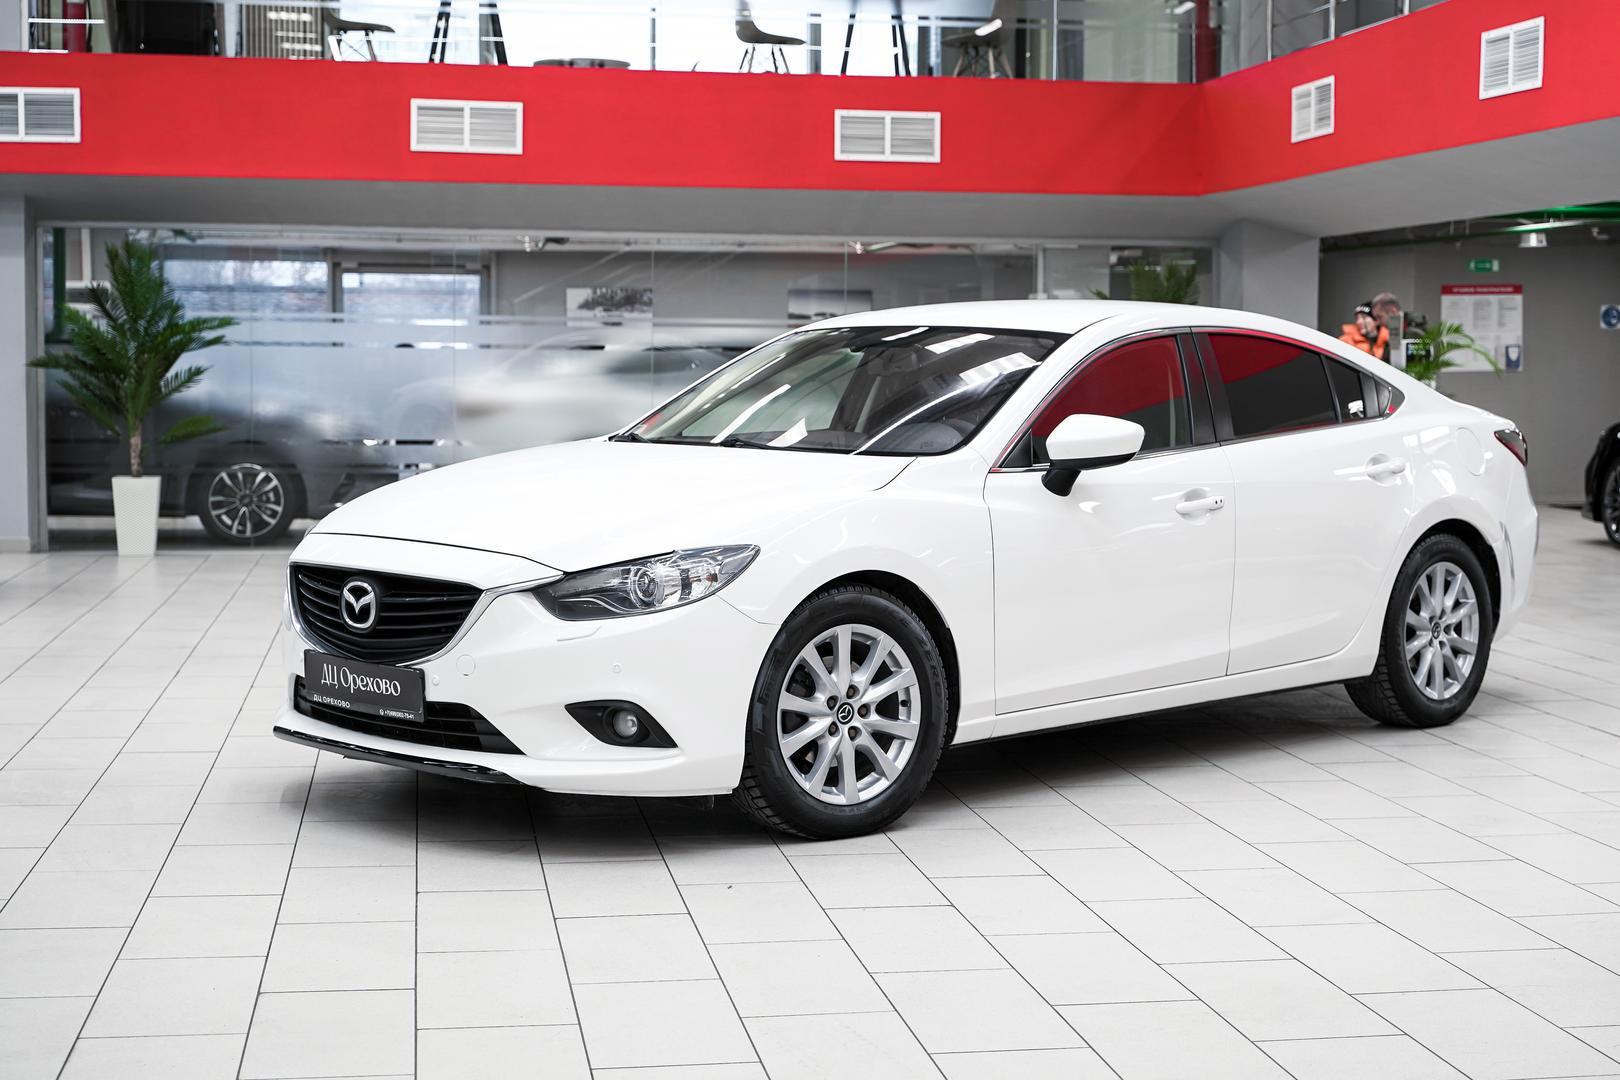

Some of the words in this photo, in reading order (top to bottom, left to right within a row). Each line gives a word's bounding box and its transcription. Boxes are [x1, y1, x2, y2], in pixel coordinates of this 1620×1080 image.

[321, 663, 338, 688] ДЦ
[340, 667, 401, 696] Орехово
[313, 694, 323, 703] ДЦ
[323, 696, 350, 709] ОРЕХОВО
